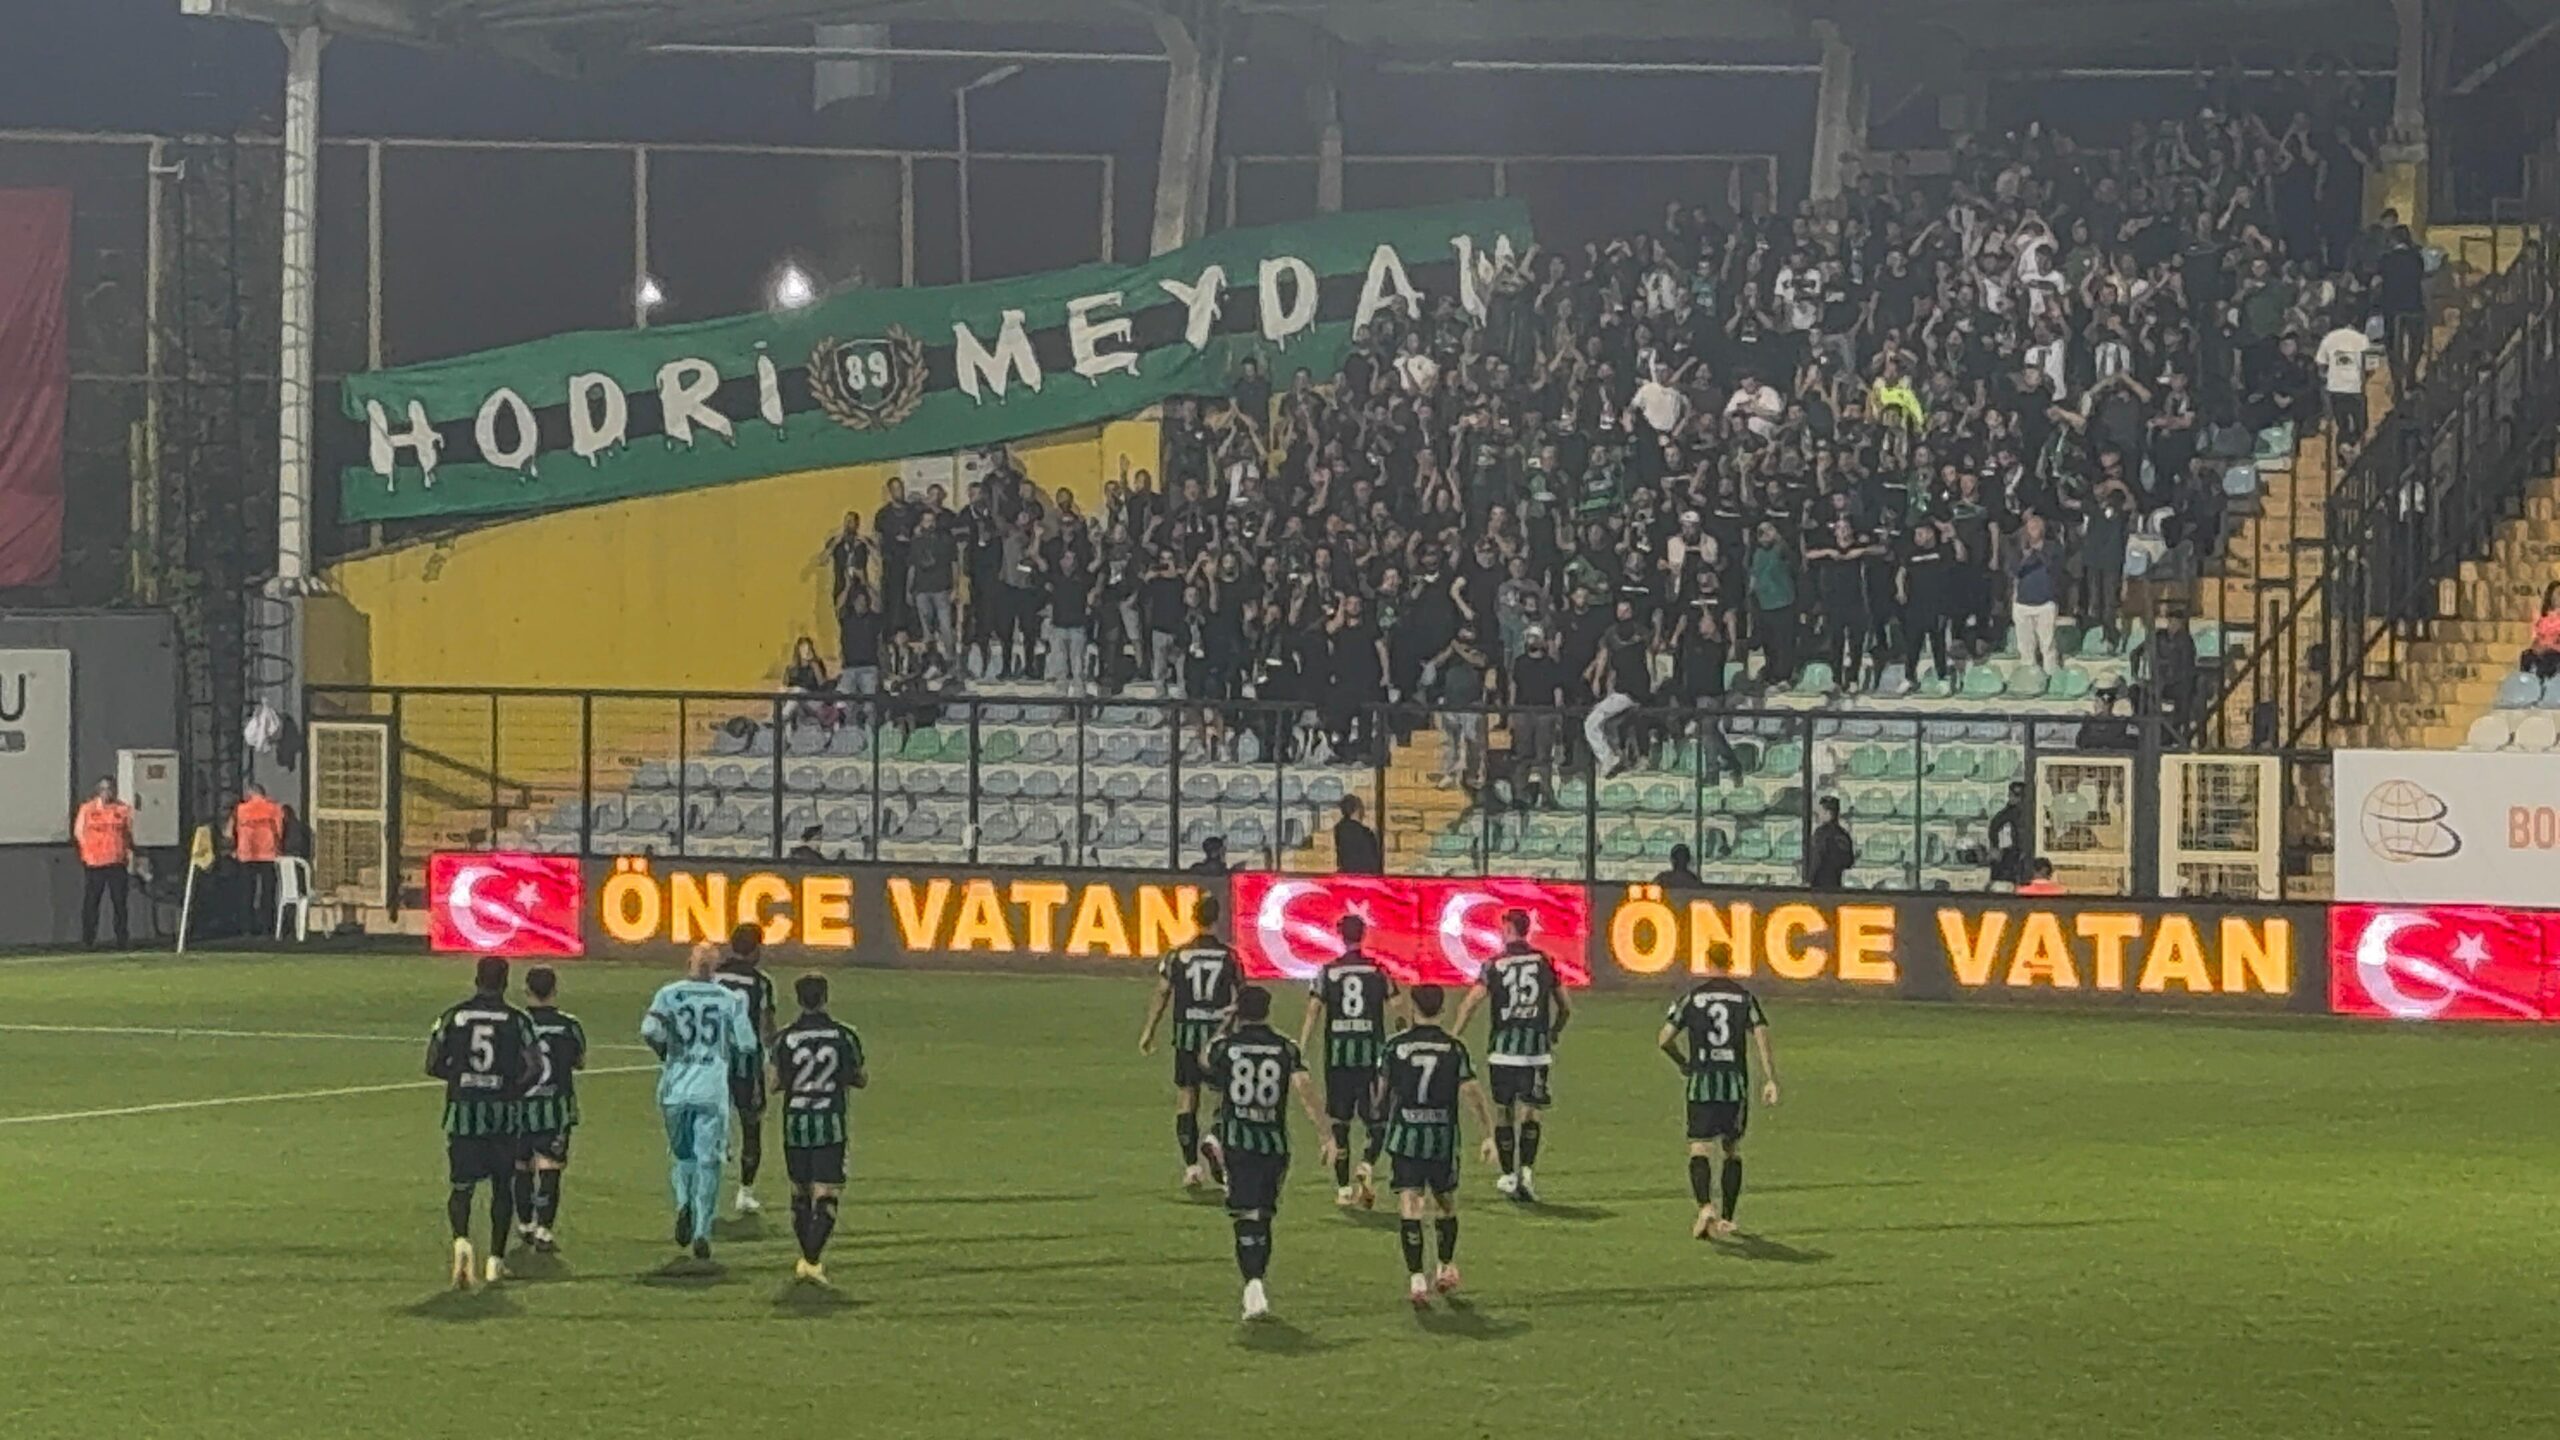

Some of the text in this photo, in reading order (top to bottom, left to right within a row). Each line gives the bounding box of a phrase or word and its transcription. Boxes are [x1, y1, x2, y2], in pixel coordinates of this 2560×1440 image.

[846, 351, 887, 391] 89
[2509, 806, 2560, 849] BO
[602, 856, 1199, 957] ÖNCE VATAN
[1612, 885, 2290, 993] ÖNCE VATAN
[1186, 960, 1224, 1001] 17
[1342, 975, 1364, 1018] 8
[1502, 963, 1539, 1007] 15
[676, 1003, 720, 1047] 35
[1707, 1002, 1730, 1047] 3
[469, 1024, 495, 1073] 5
[792, 1046, 838, 1092] 22
[1229, 1058, 1281, 1107] 88
[1410, 1055, 1438, 1104] 7
